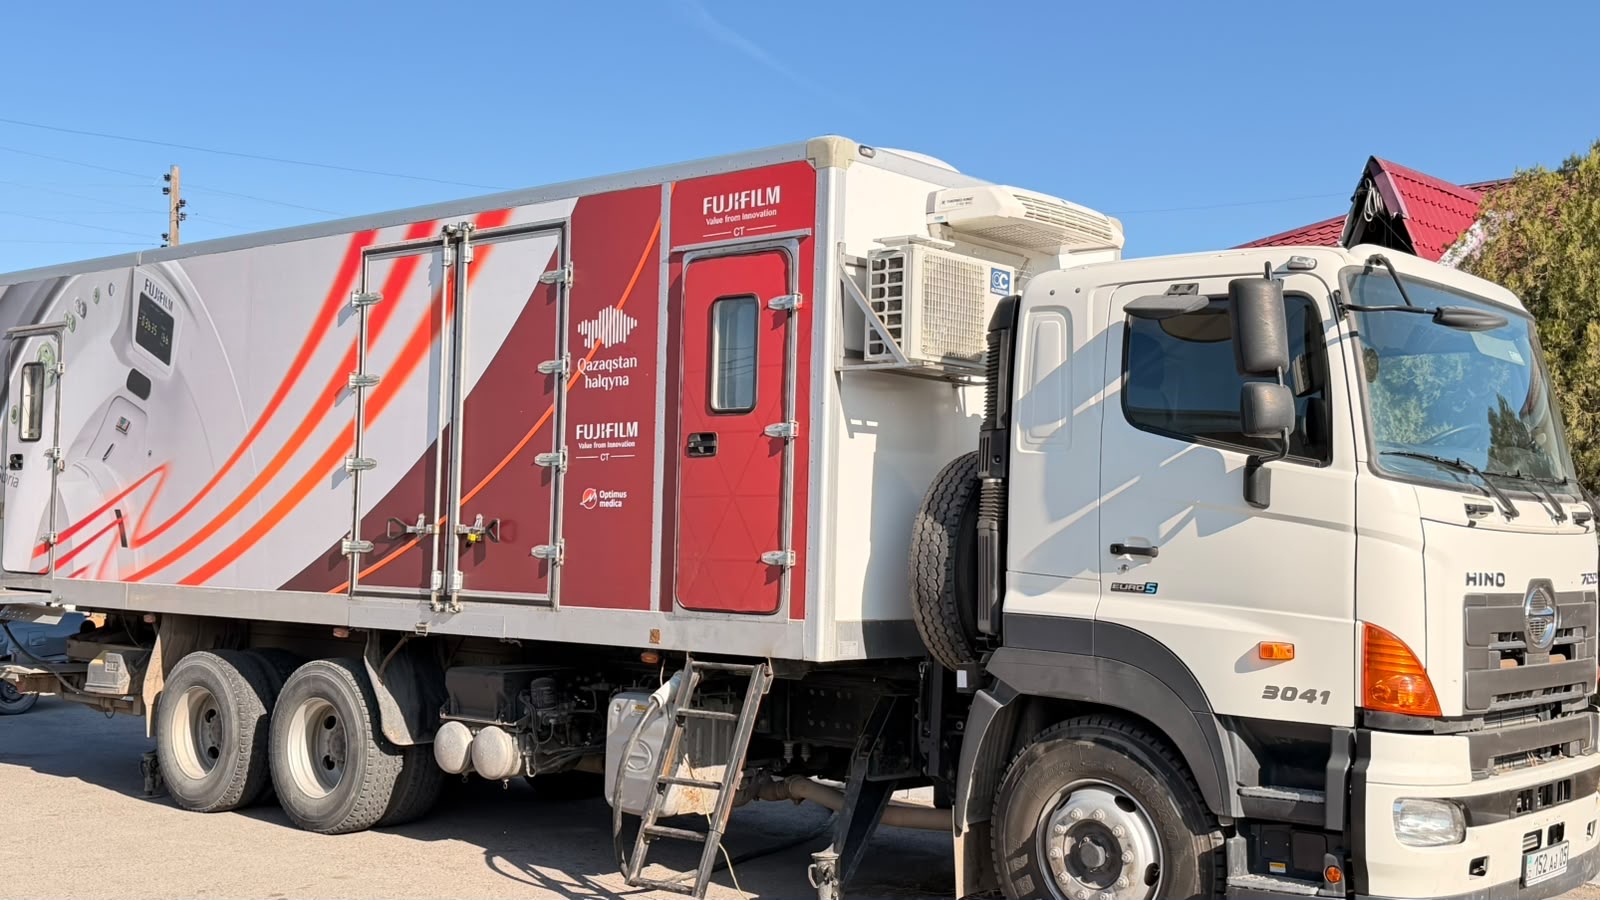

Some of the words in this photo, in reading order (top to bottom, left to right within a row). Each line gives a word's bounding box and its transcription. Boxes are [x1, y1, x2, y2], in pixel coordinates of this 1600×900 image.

[703, 185, 780, 215] FUJIFILM
[706, 217, 724, 225] Value
[725, 214, 740, 223] from
[742, 209, 777, 220] Innovation
[733, 226, 745, 237] CT
[144, 278, 173, 313] FUJIFILM
[577, 355, 638, 375] Qazaqstan
[585, 373, 630, 391] halqyna
[575, 421, 639, 440] FUJIFILM
[578, 442, 592, 450] Value
[593, 441, 606, 449] from
[607, 440, 636, 448] Innovation
[600, 453, 610, 462] CT
[599, 490, 627, 500] Optimus
[599, 499, 623, 508] medica
[1465, 572, 1505, 587] HINO
[1261, 685, 1331, 706] 3041
[1535, 854, 1547, 875] 152
